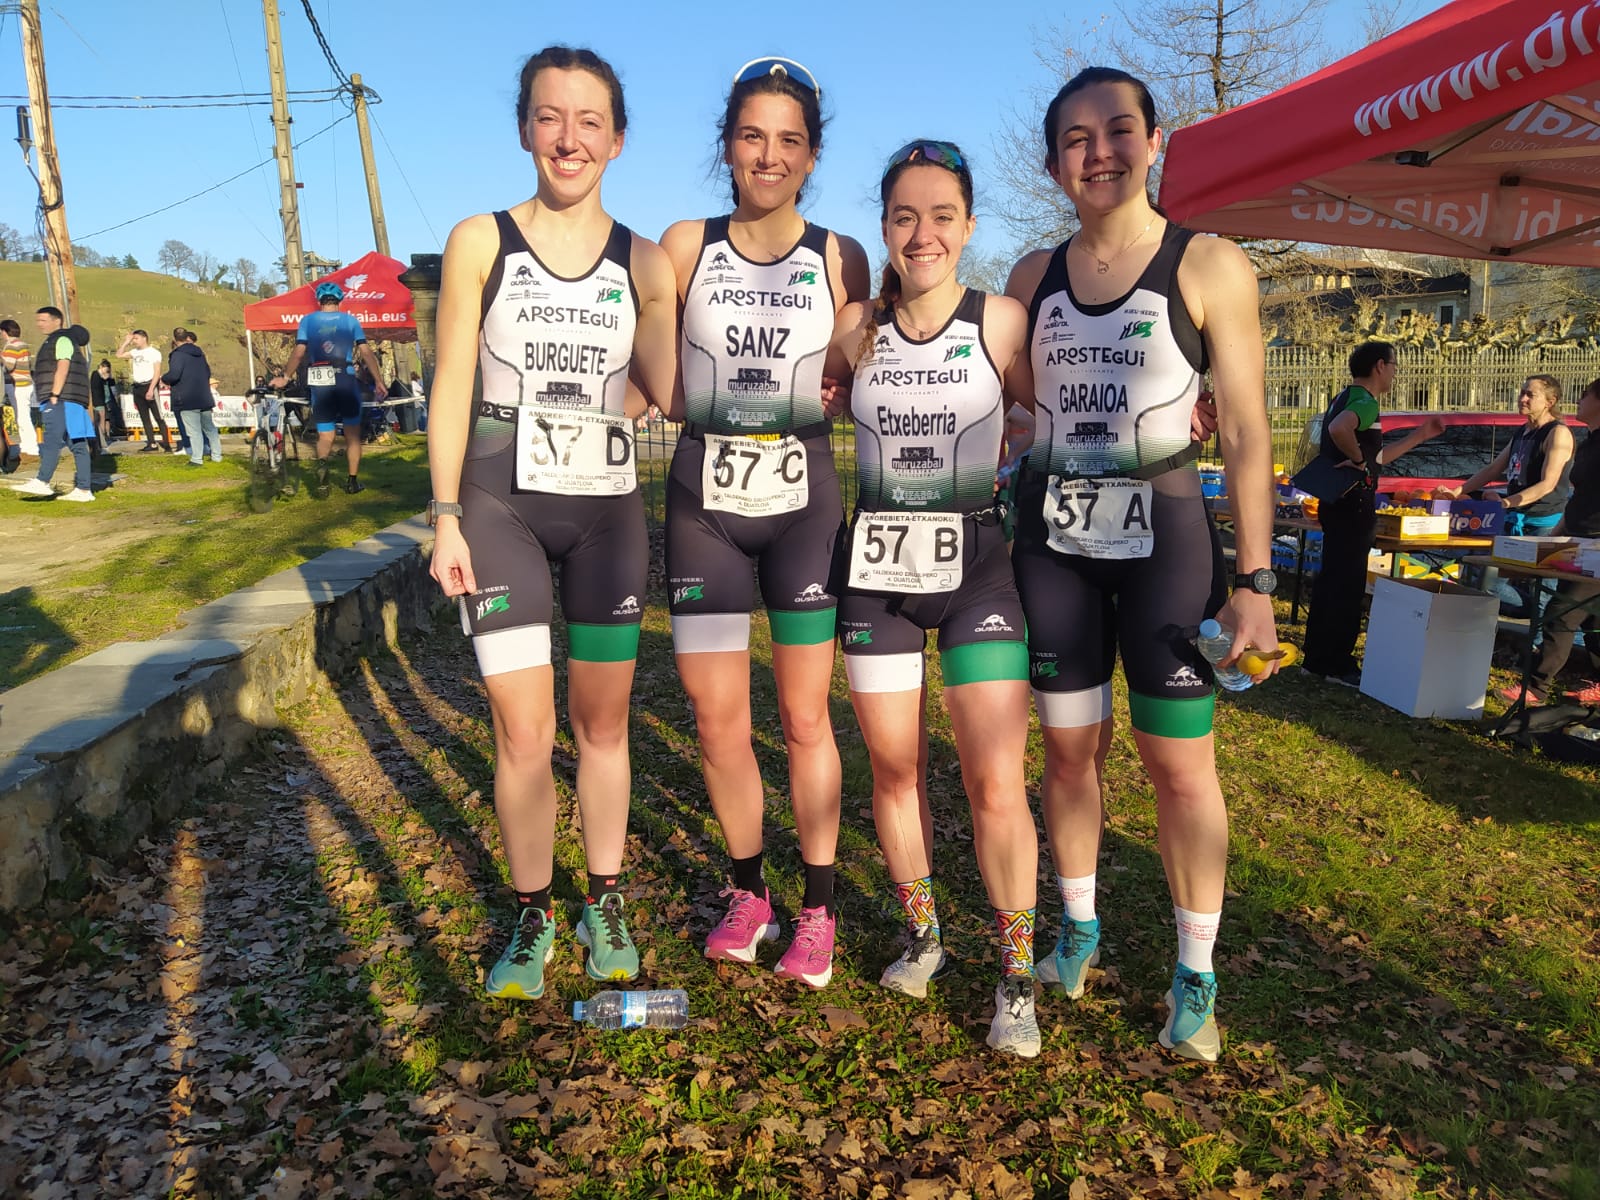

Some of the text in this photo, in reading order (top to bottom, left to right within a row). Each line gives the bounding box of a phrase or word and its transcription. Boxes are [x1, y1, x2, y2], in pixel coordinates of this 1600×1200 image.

[1354, 0, 1600, 136] www.bi
[726, 324, 791, 359] SANZ
[525, 342, 607, 375] BURGUETE
[537, 393, 590, 404] muruzabal
[728, 380, 779, 391] muruzabal
[1060, 383, 1128, 413] GARAIOA
[877, 405, 956, 436] Etxeberria
[606, 426, 631, 466] D
[1066, 432, 1117, 443] muruzabal
[781, 449, 804, 484] C
[892, 457, 942, 469] muruzabal
[1053, 492, 1149, 531] 57 A
[864, 524, 959, 564] 57 B
